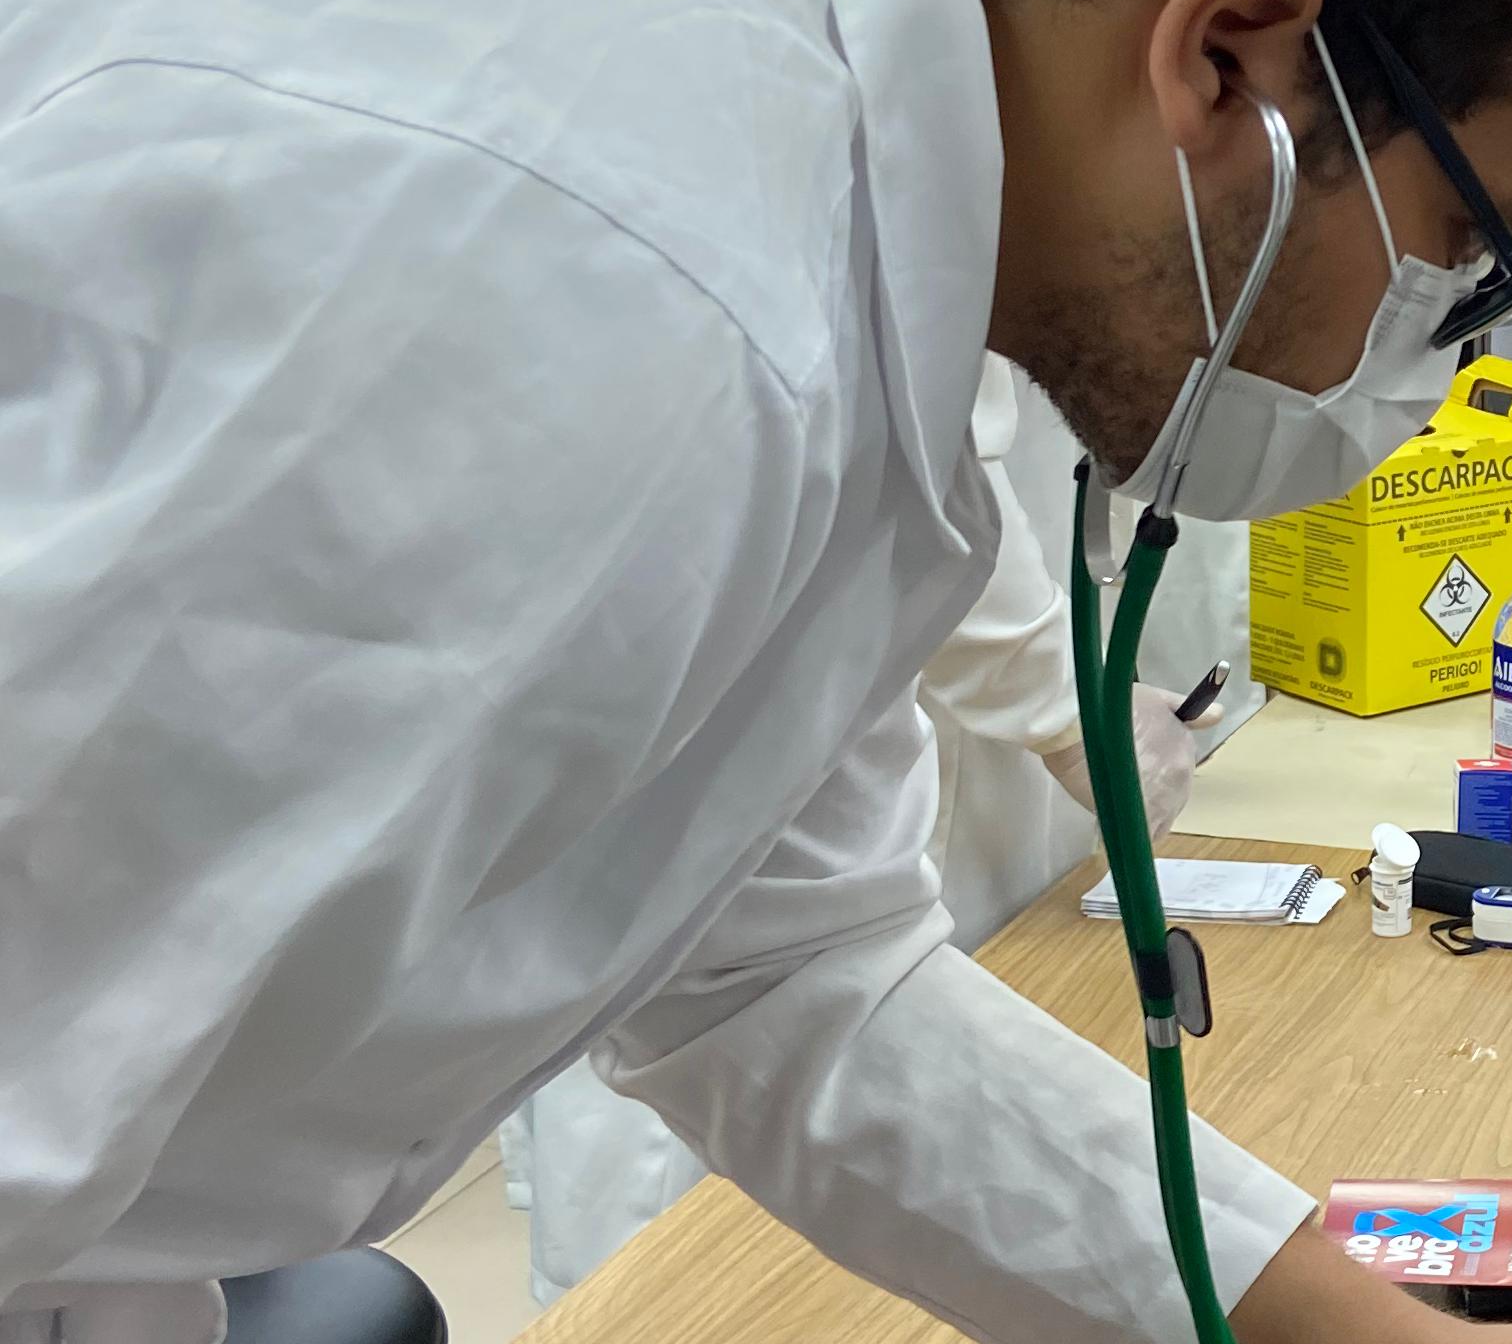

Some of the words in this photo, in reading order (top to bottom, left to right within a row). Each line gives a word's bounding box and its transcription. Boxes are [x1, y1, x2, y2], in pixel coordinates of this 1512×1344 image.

[1430, 659, 1482, 684] PERIGO!
[1454, 1193, 1500, 1253] azul
[1383, 1234, 1424, 1263] ve
[1403, 1237, 1460, 1276] bro
